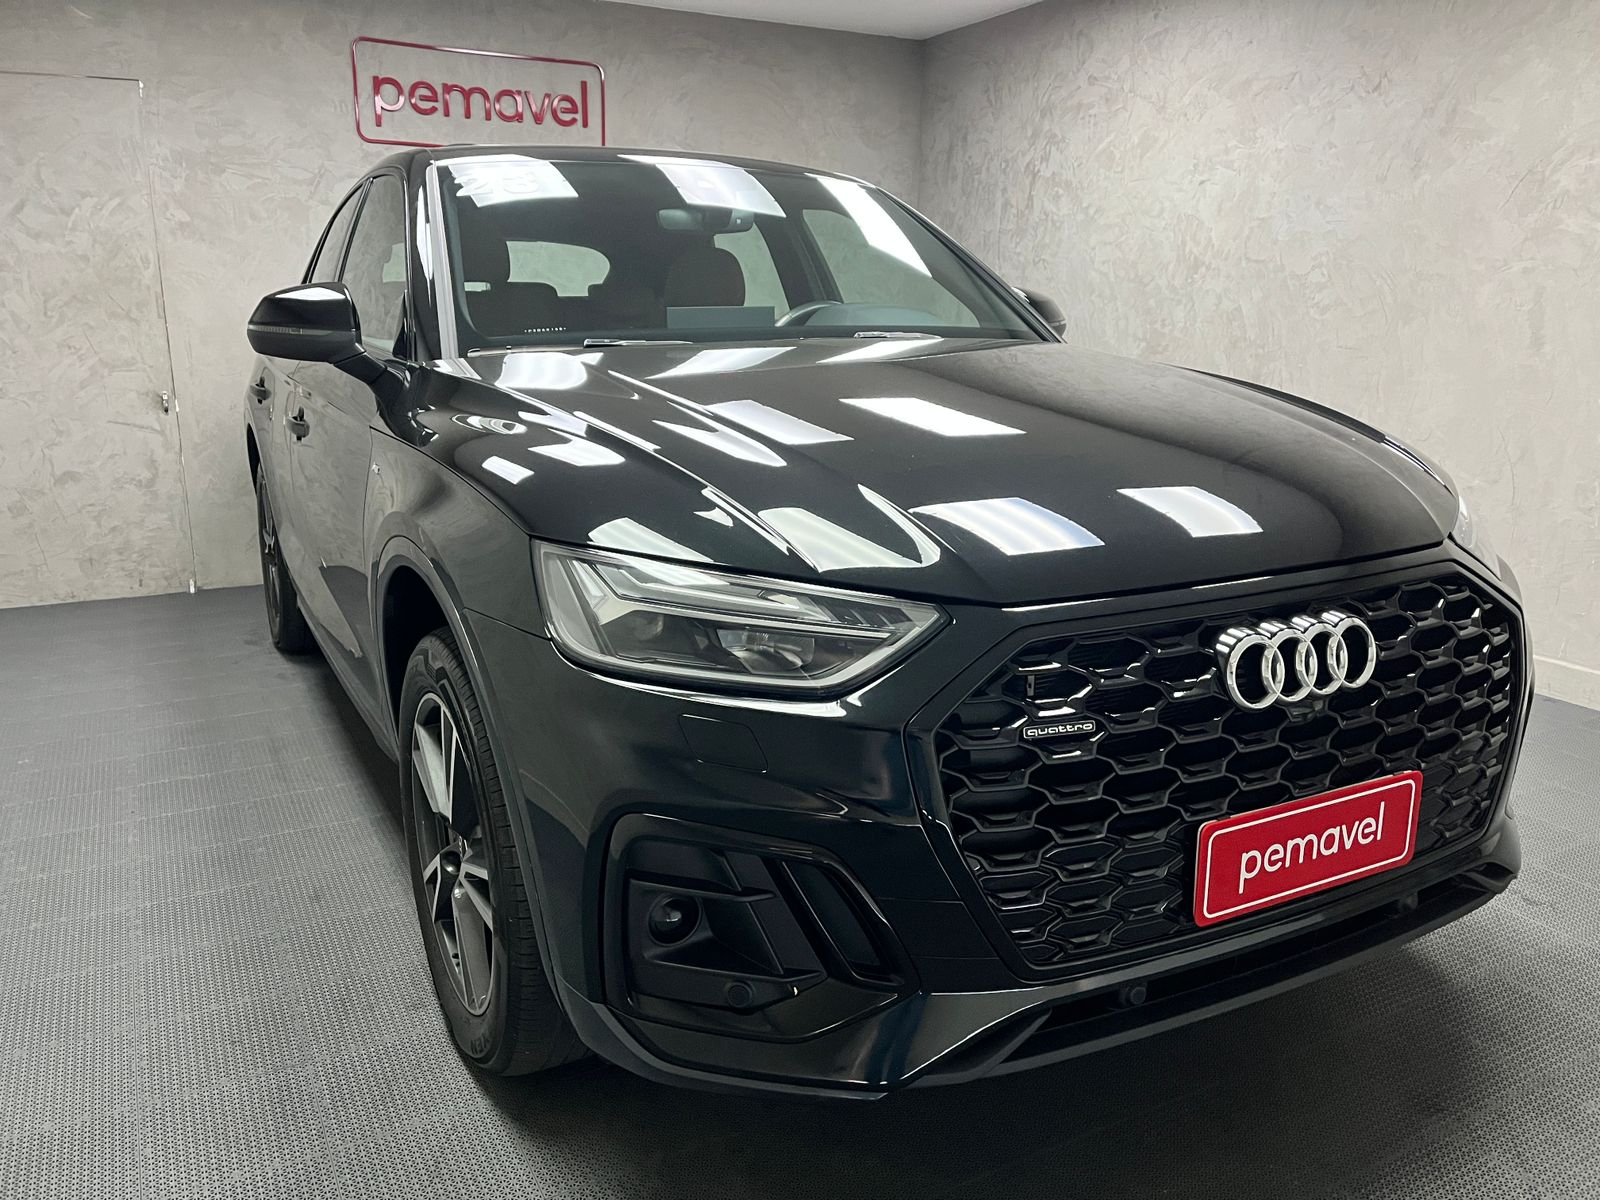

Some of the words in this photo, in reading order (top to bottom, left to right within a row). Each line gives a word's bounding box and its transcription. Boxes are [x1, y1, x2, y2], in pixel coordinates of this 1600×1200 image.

[372, 75, 589, 129] pemavel
[1027, 723, 1093, 737] quattro
[1238, 801, 1385, 895] pemavel
